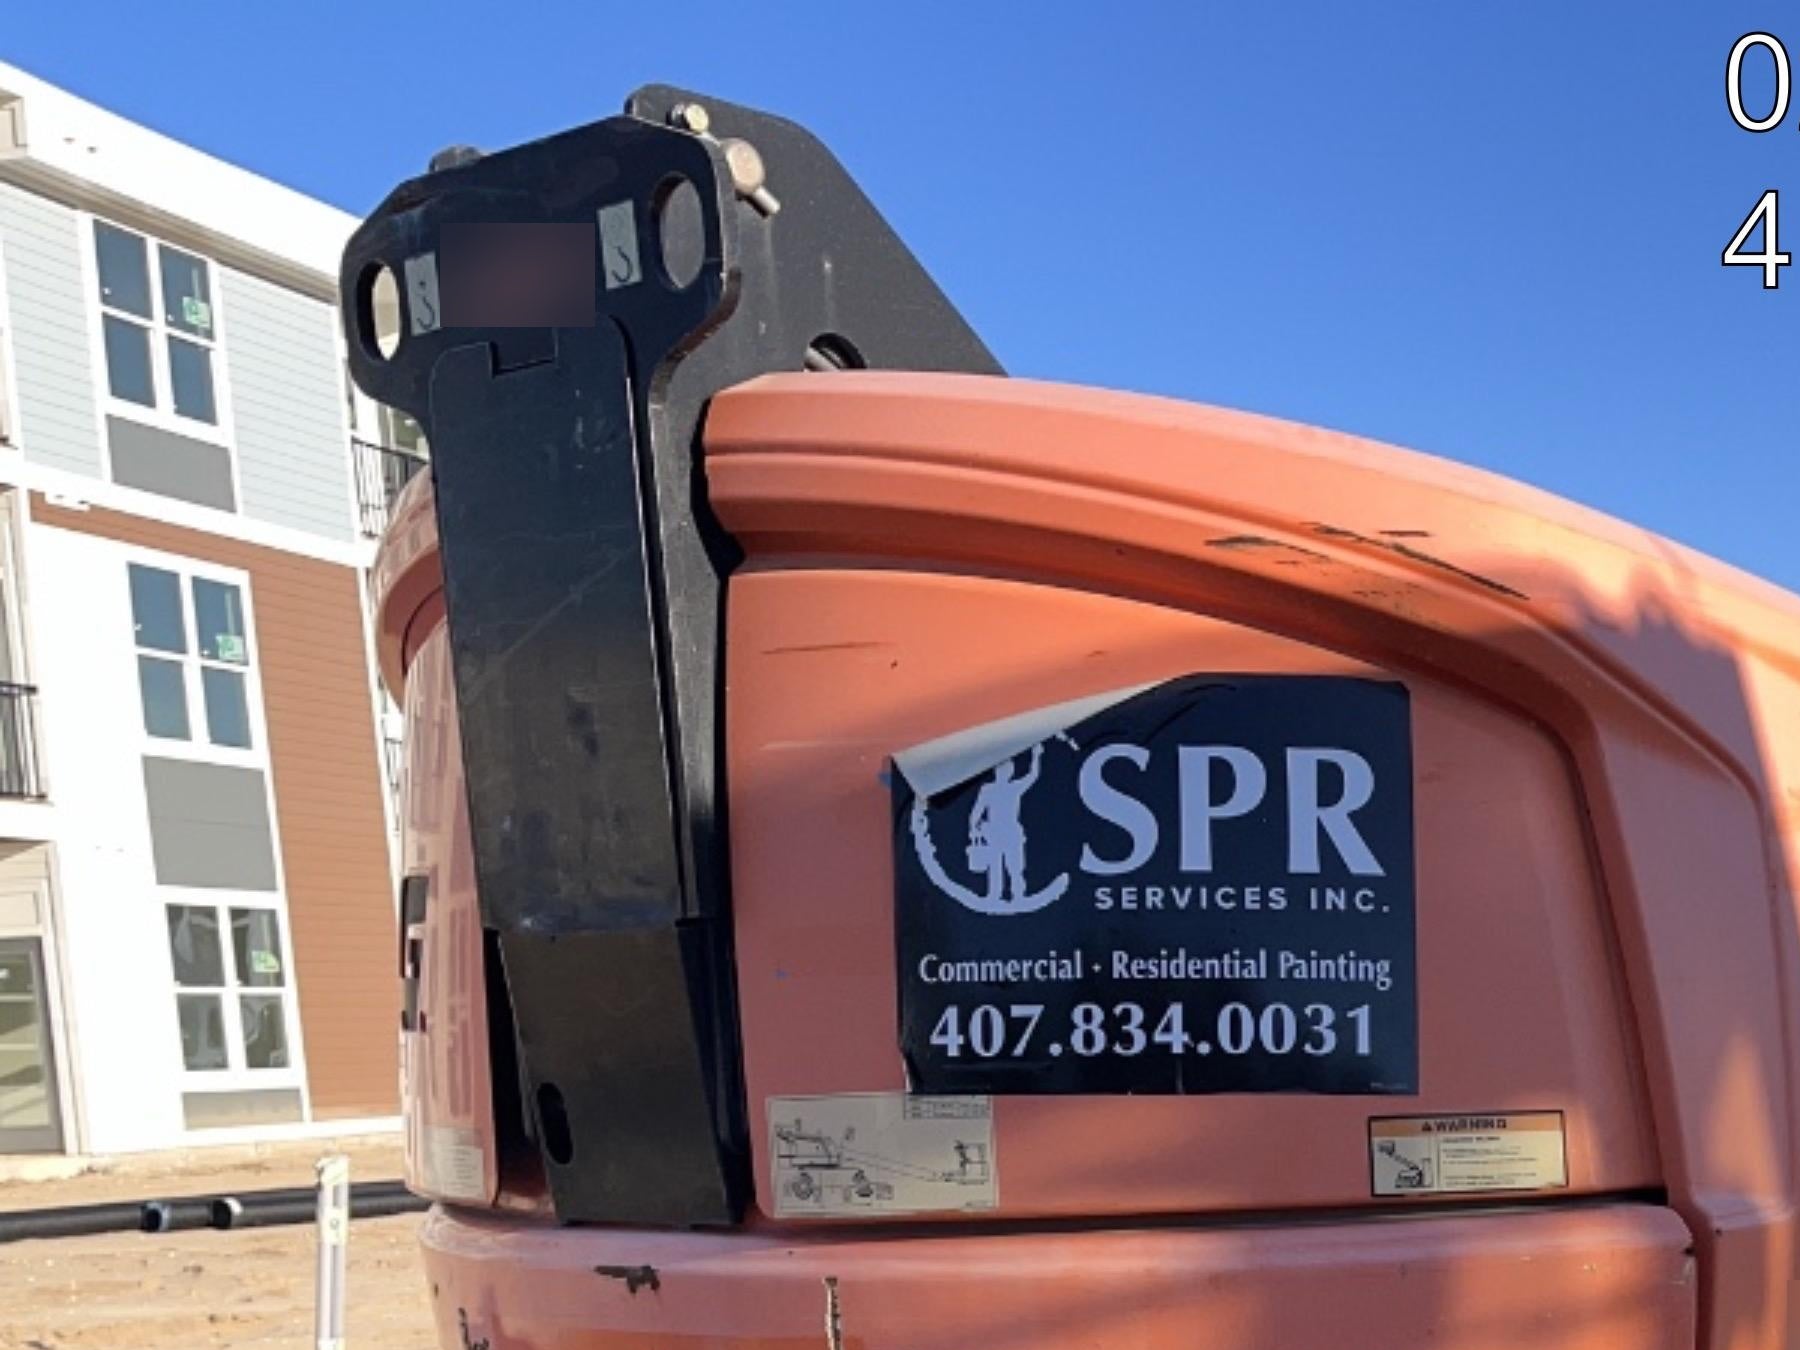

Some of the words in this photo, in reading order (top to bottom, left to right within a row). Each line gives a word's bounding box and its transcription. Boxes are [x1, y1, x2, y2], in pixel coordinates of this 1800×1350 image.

[1078, 743, 1386, 877] SPR
[1095, 886, 1289, 911] SERVICES
[1309, 888, 1391, 914] INC.
[919, 950, 1083, 984] Commercial
[1111, 948, 1267, 980] Residential
[1279, 950, 1392, 991] Painting
[929, 1002, 1372, 1057] 407.834.0031
